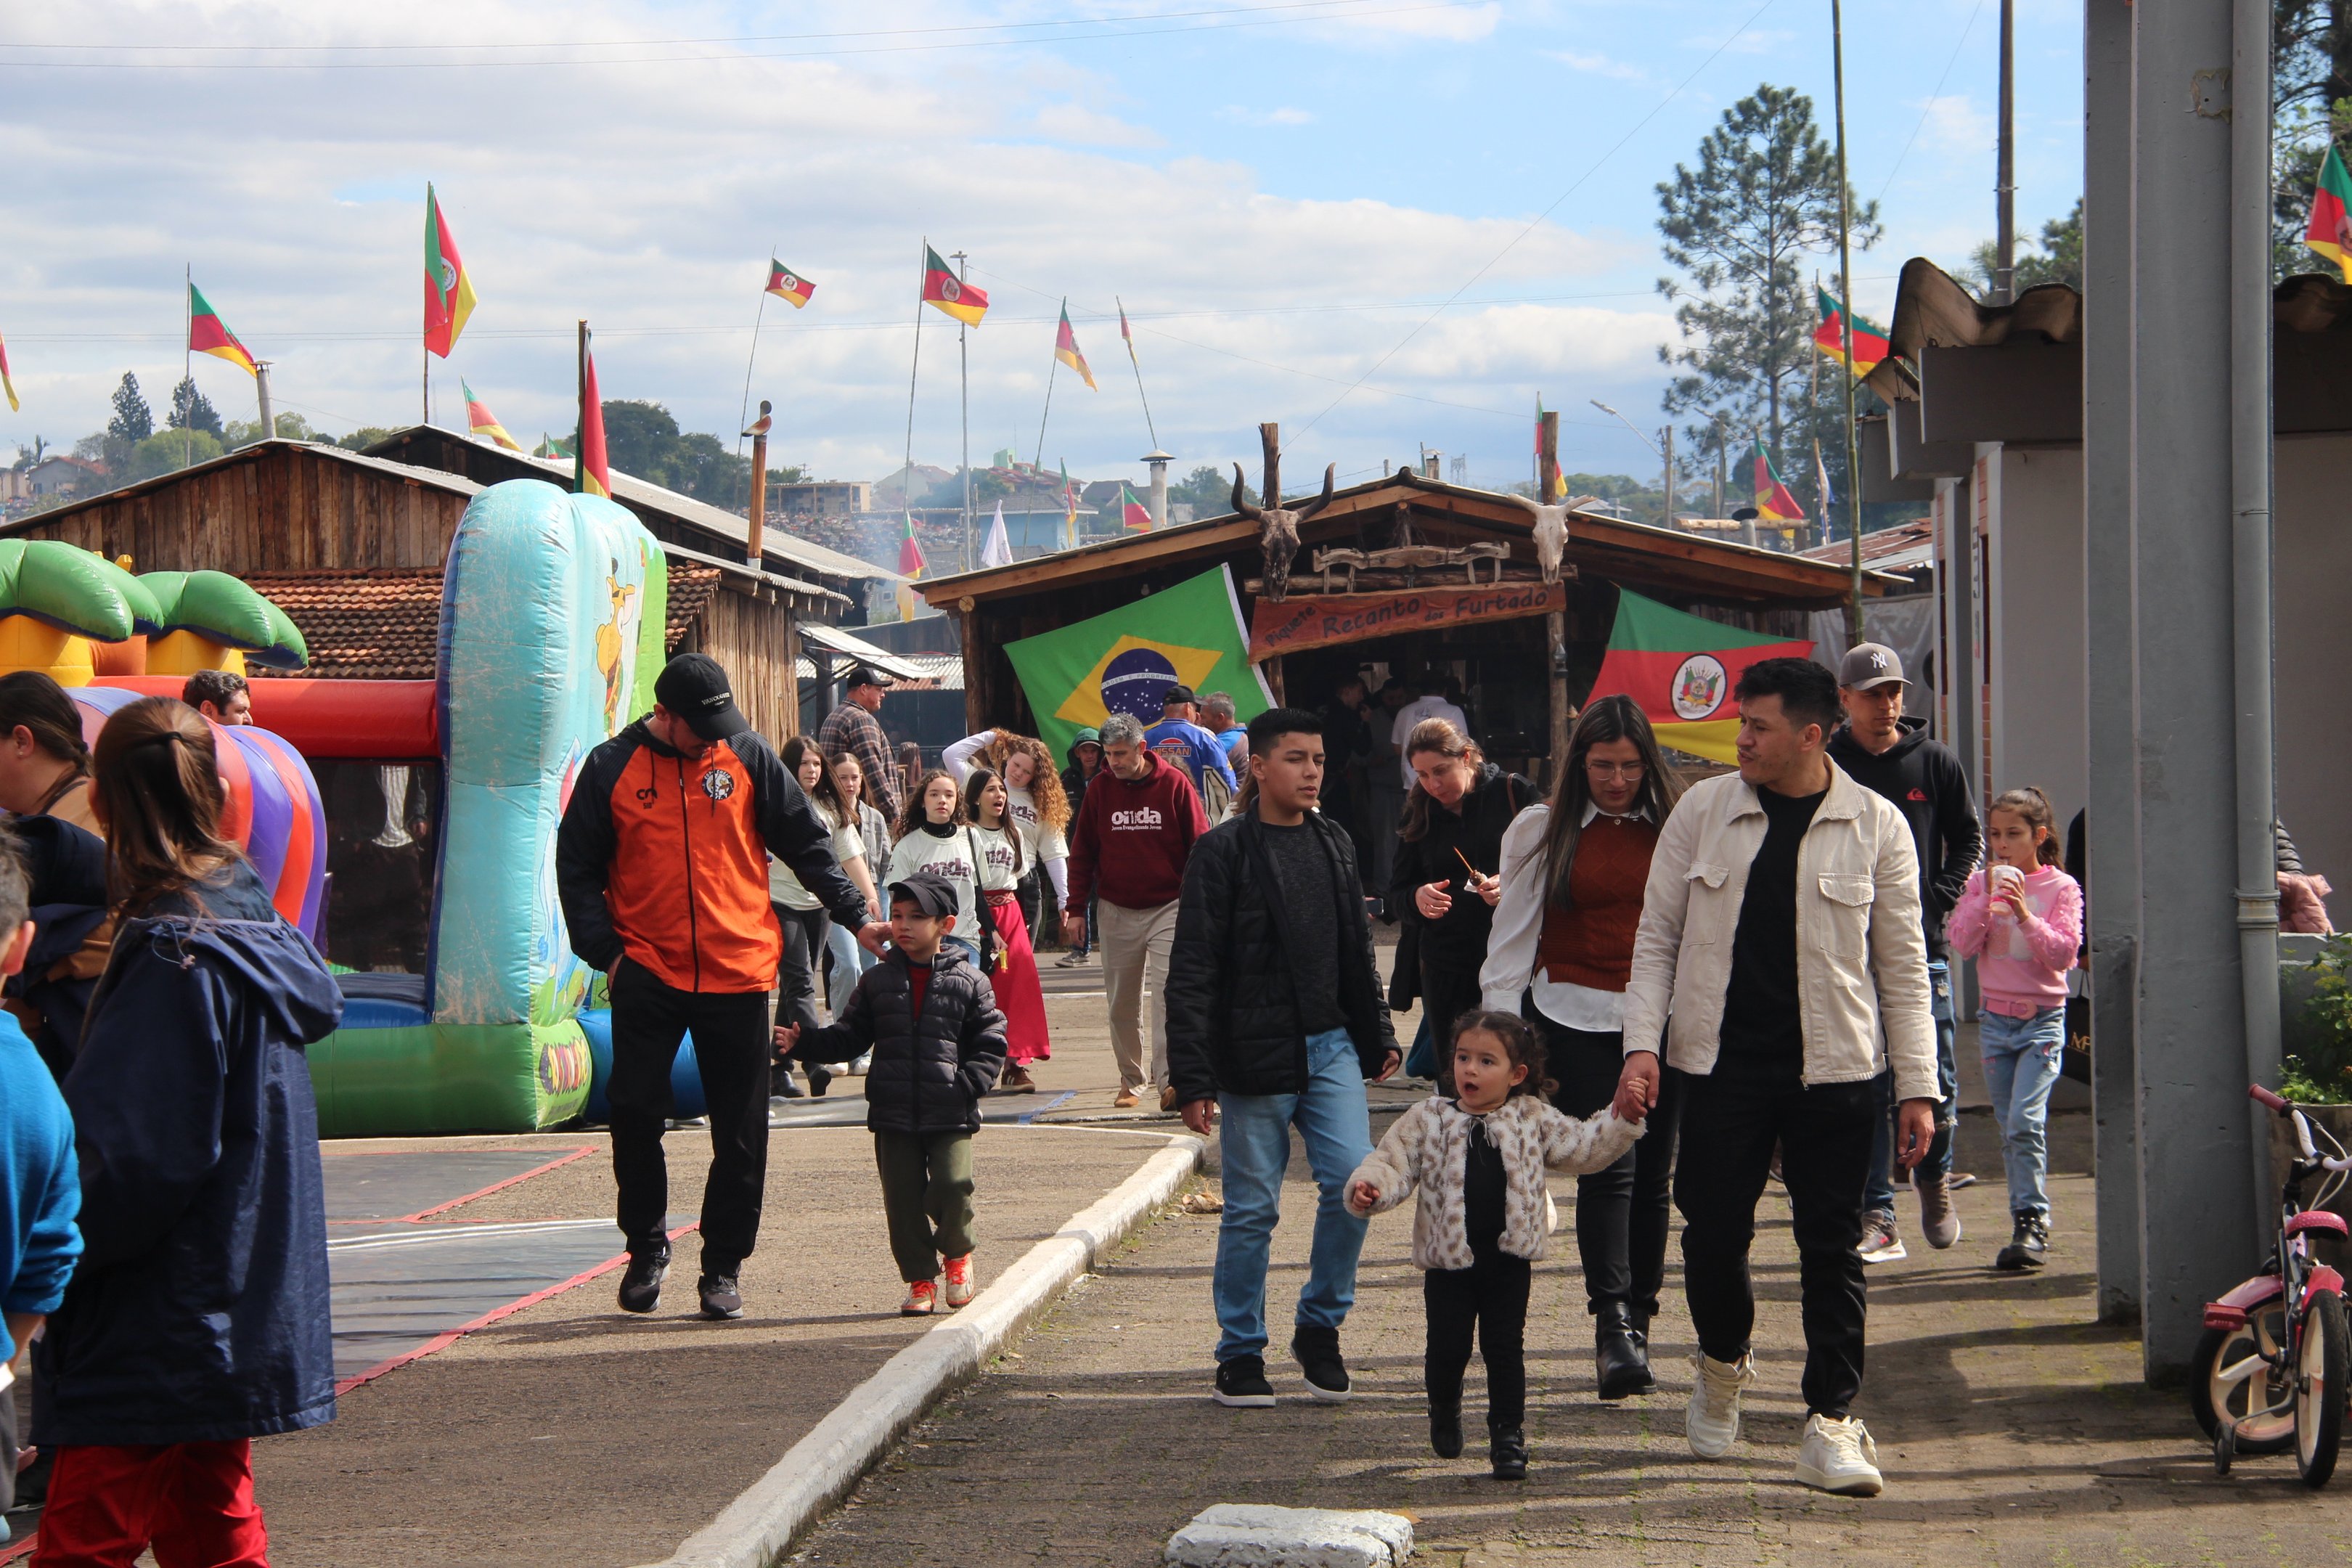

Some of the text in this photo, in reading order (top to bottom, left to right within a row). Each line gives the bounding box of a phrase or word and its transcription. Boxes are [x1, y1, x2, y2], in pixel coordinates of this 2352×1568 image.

[1322, 597, 1421, 639] Recanto
[1424, 610, 1445, 622] dos
[1455, 586, 1548, 617] Furtado
[1101, 676, 1124, 688] ORDEM
[1137, 672, 1176, 681] PROGRESSO
[1153, 747, 1190, 756] NISSAN
